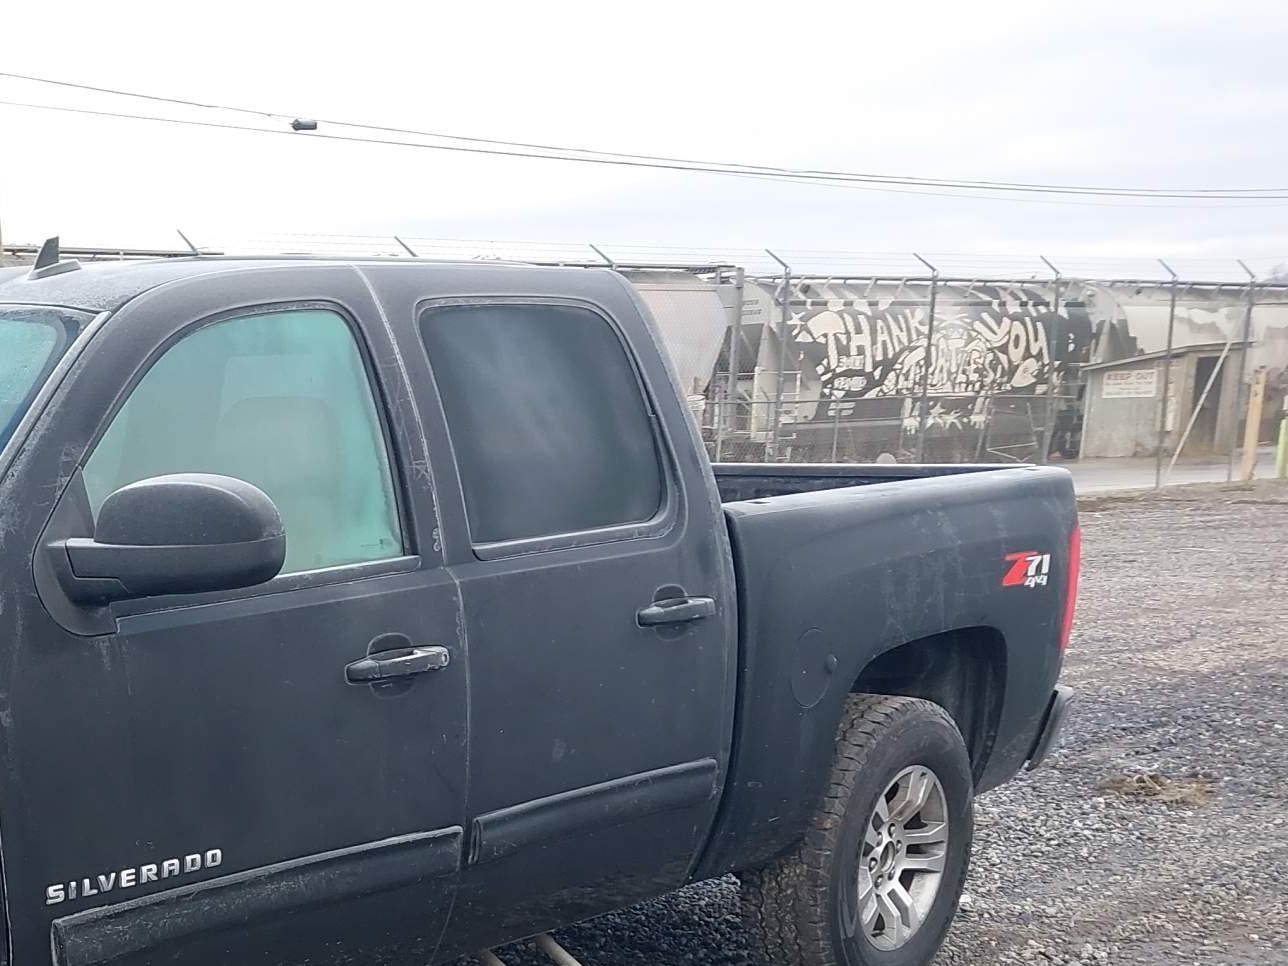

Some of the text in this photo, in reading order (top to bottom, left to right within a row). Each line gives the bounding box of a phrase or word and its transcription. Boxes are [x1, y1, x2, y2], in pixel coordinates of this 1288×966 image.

[807, 308, 928, 372] THANK
[974, 312, 1050, 364] YOU
[1002, 551, 1051, 587] Z71
[45, 848, 223, 905] SILVERADO
